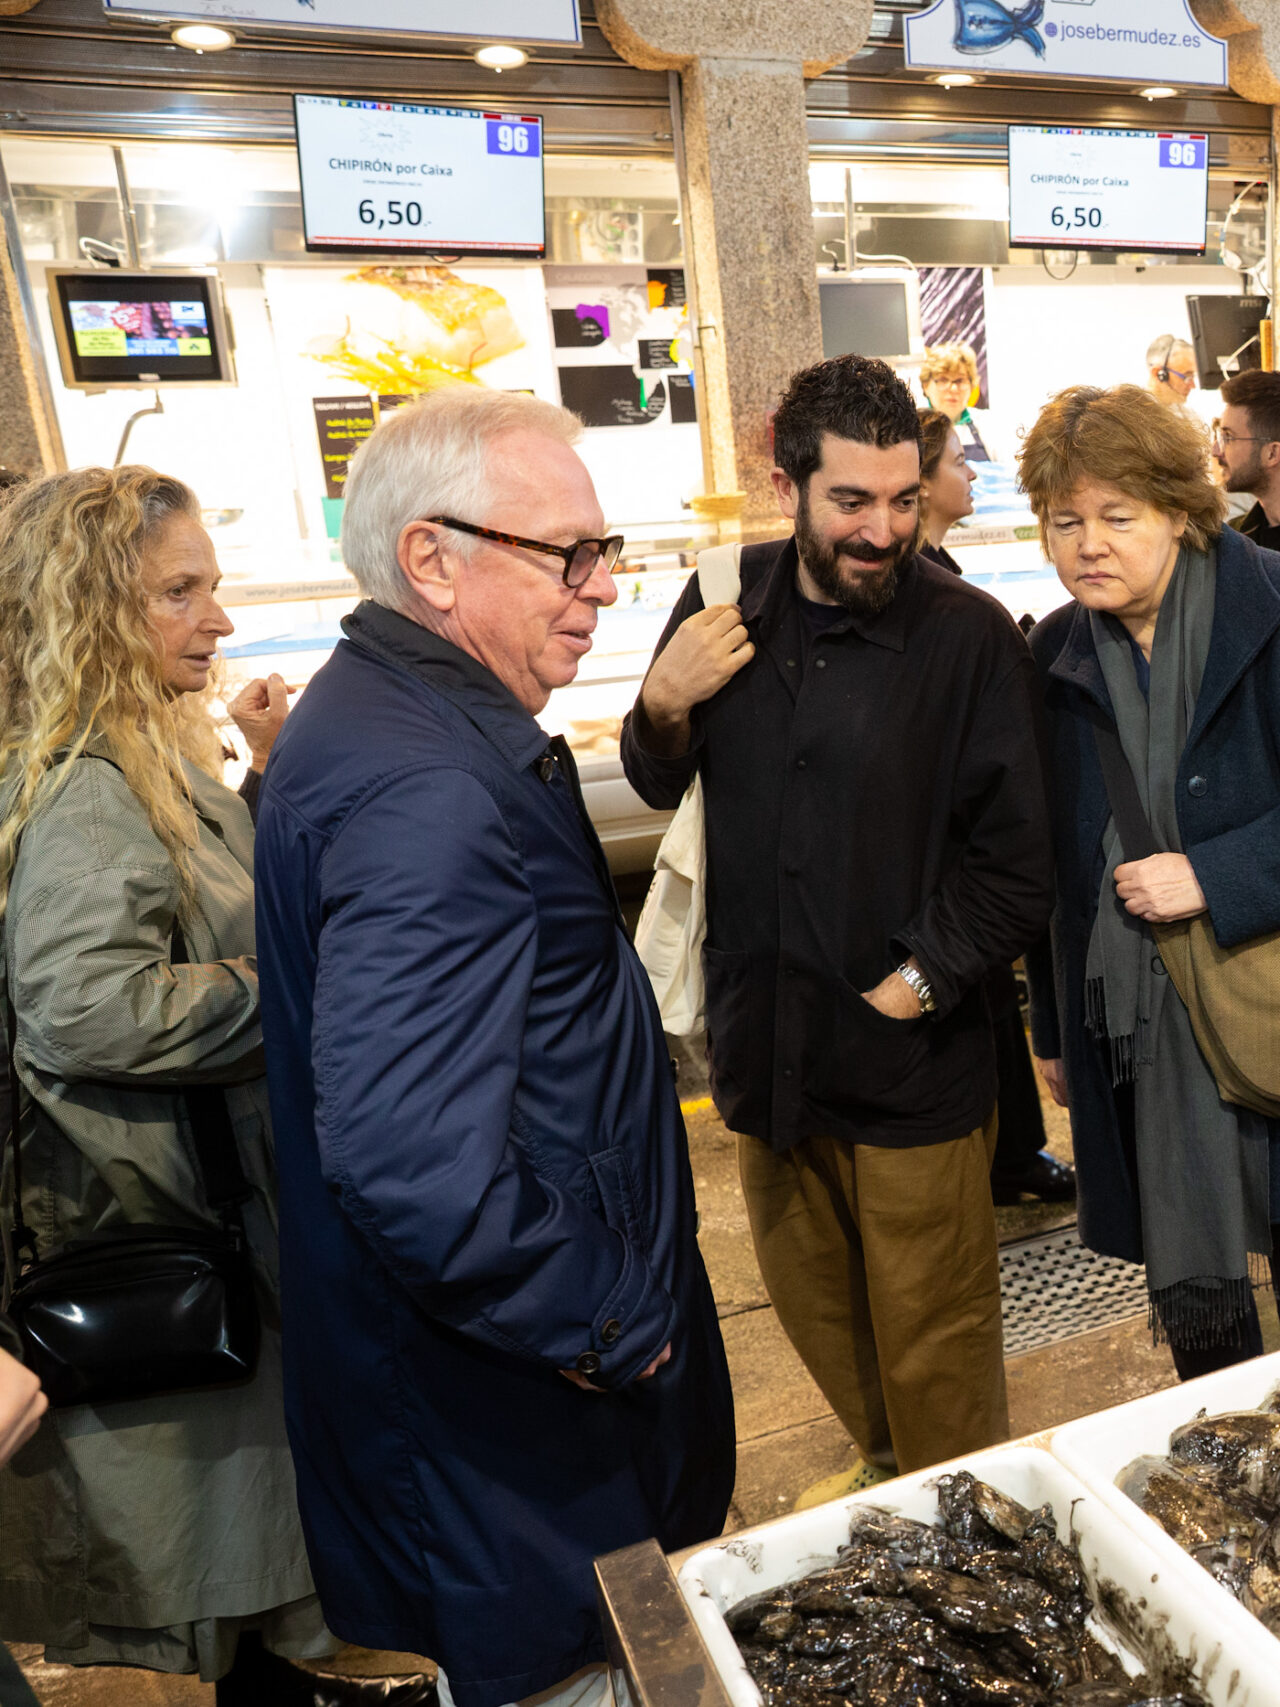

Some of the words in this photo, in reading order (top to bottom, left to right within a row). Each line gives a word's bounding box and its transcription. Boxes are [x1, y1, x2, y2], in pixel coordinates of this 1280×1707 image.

[1060, 20, 1201, 49] josebermudez.es
[497, 124, 529, 153] 96
[1168, 142, 1196, 166] 96
[328, 157, 392, 173] CHIPIRÓN
[396, 164, 416, 175] por
[420, 164, 453, 177] Caixa
[1030, 173, 1080, 185] CHIPIRÓN
[1083, 178, 1099, 187] por
[1102, 177, 1129, 187] Caixa
